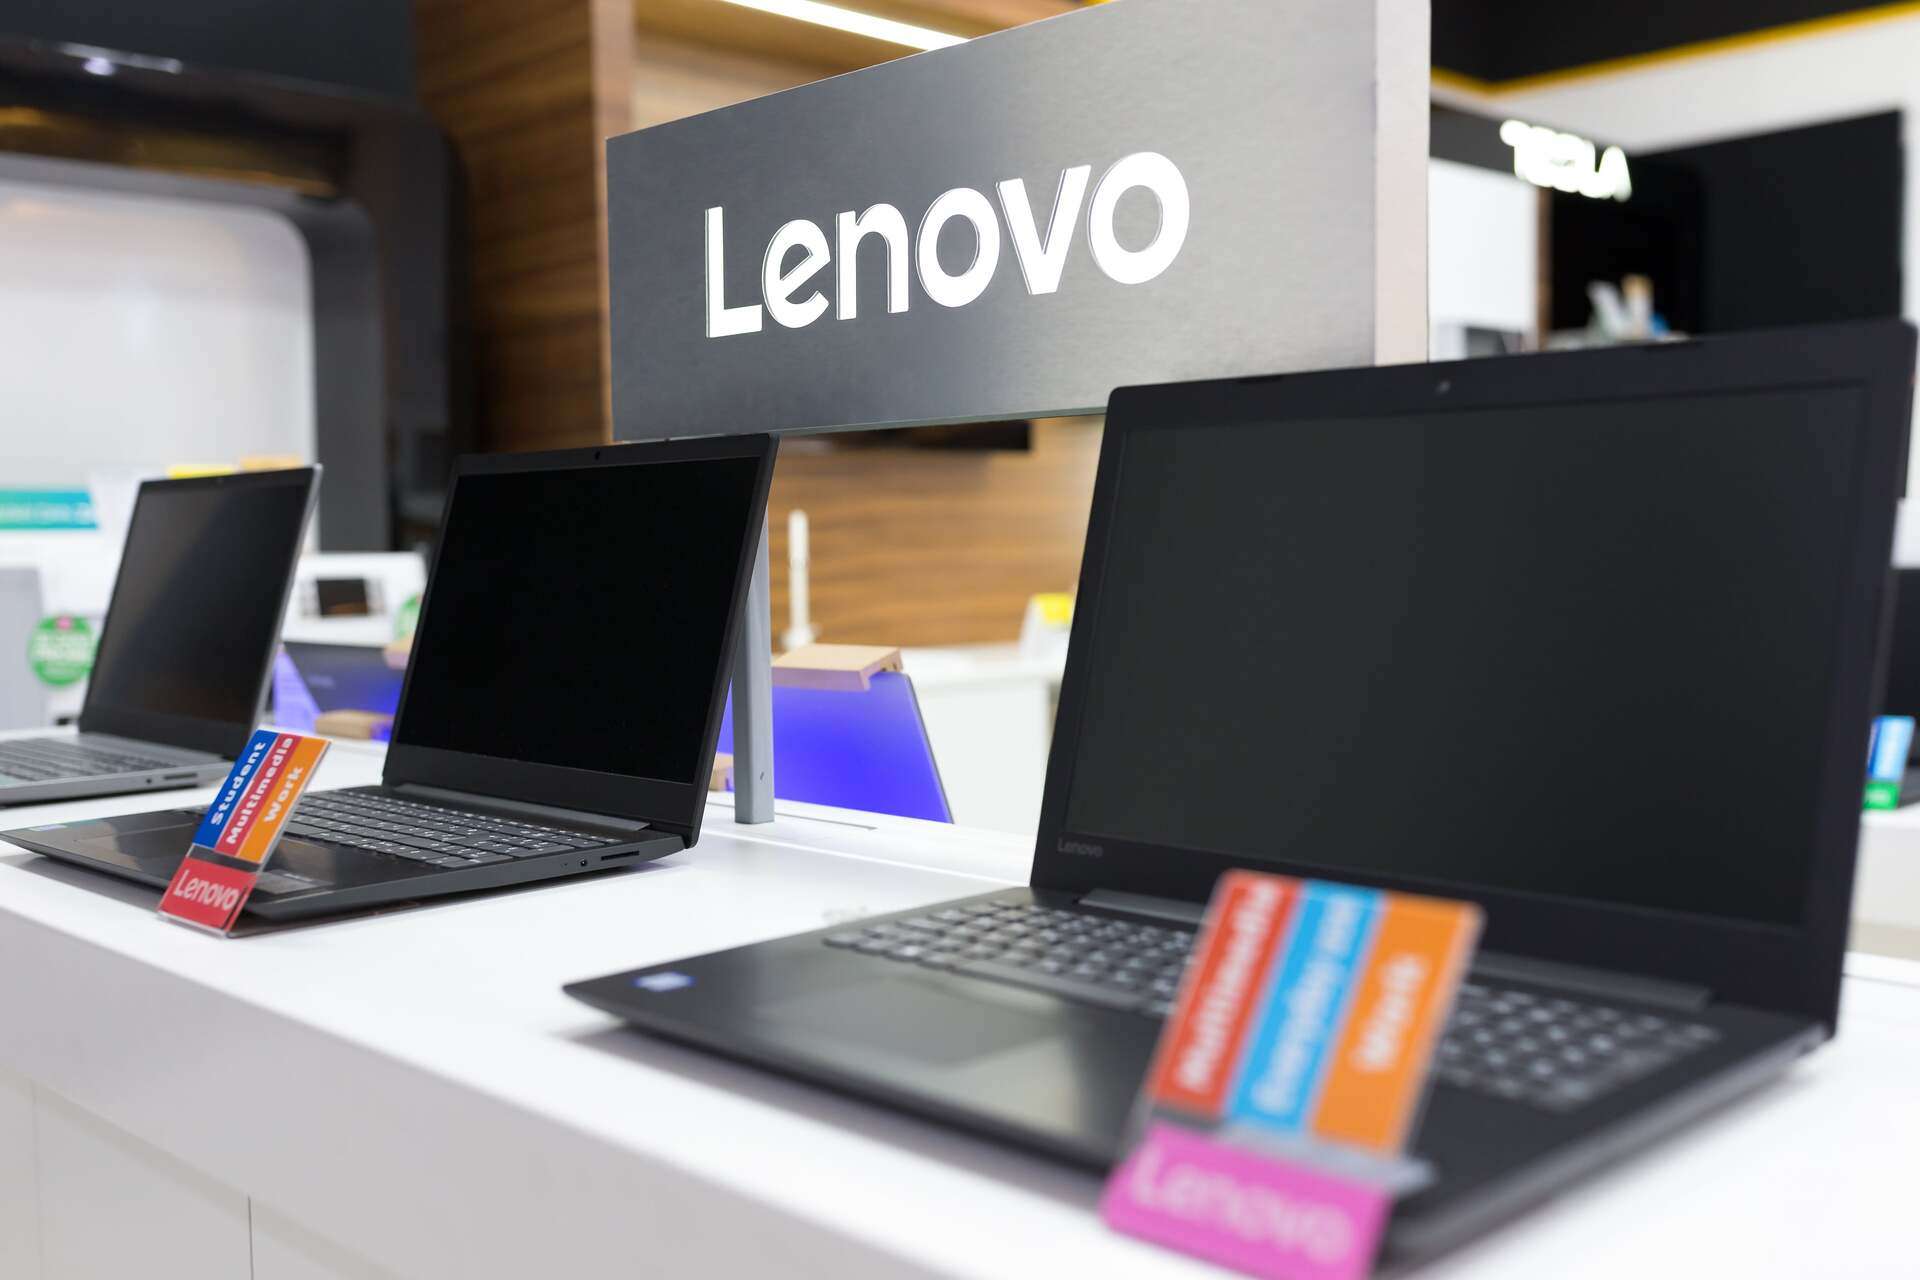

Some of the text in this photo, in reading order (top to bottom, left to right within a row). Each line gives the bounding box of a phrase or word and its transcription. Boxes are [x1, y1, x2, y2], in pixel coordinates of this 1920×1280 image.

[705, 151, 1190, 338] Lenovo
[211, 741, 266, 825] Student
[226, 737, 293, 844] Multimedia
[264, 766, 304, 823] Work
[172, 869, 241, 911] Lenovo
[1057, 837, 1104, 859] Lenovo
[1130, 1143, 1355, 1263] Lenovo
